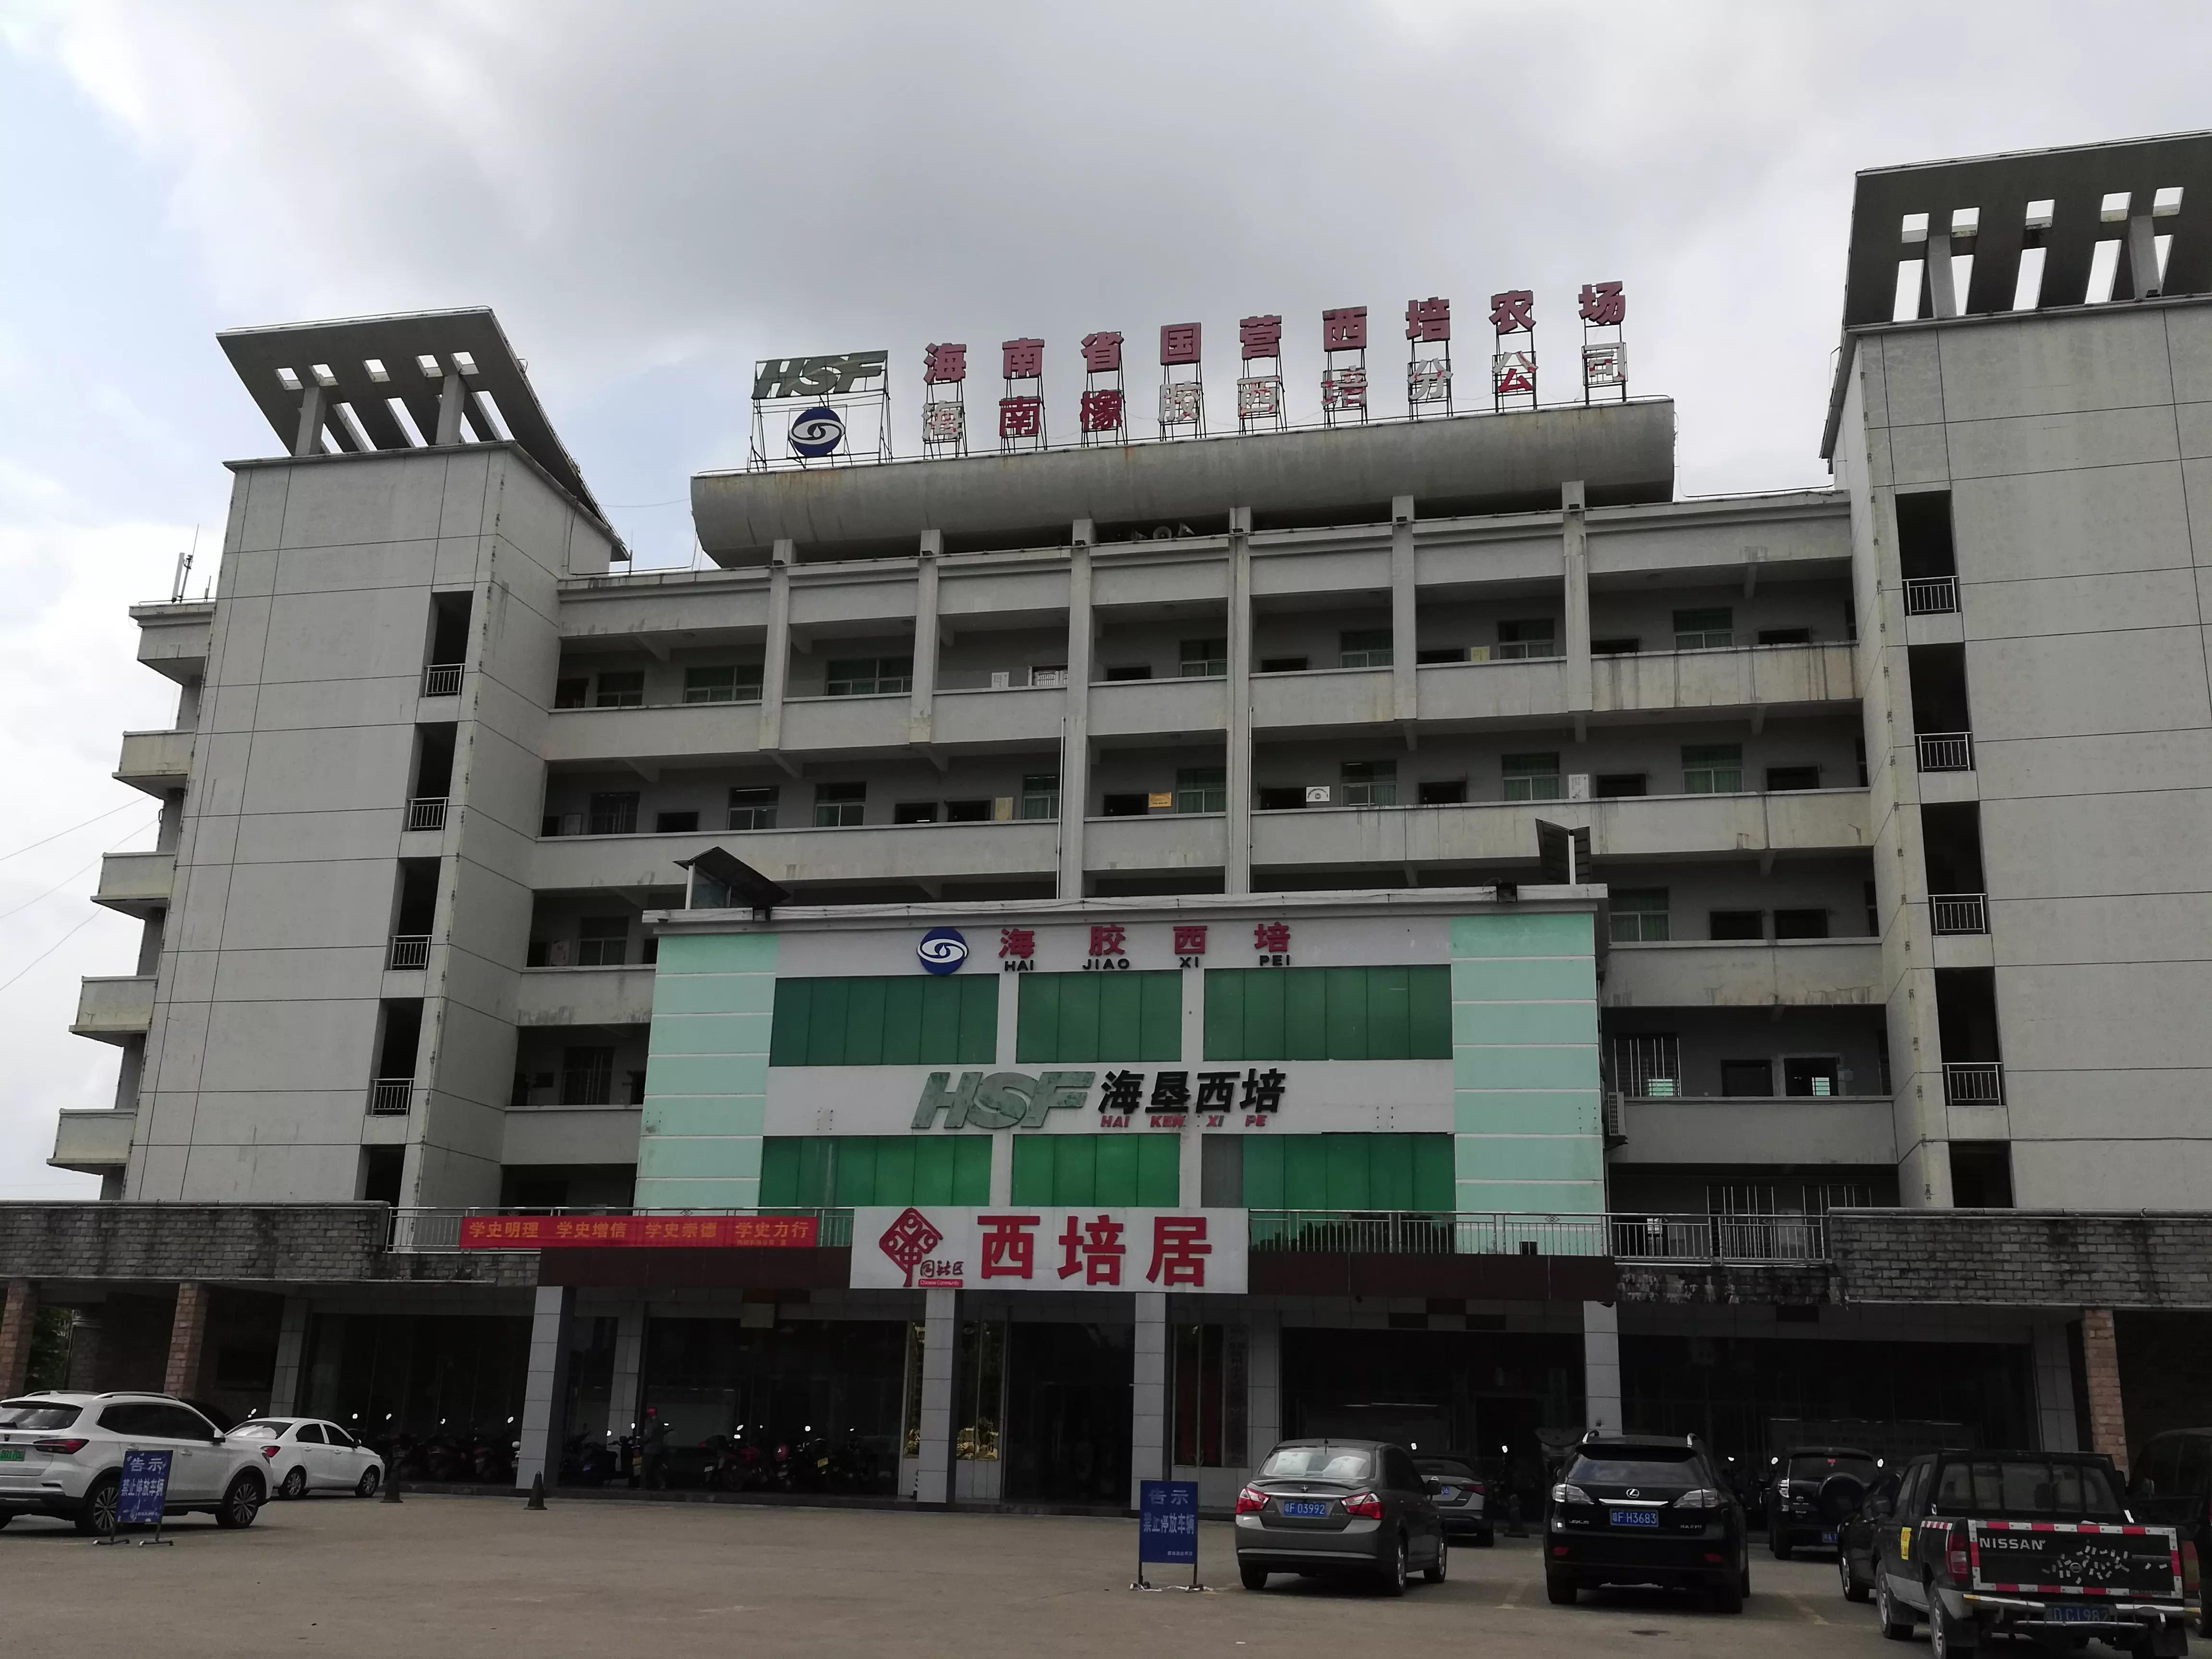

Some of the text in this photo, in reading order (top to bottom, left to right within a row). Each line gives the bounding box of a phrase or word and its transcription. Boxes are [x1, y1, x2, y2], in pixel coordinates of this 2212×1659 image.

[924, 281, 1626, 384] 海南省国营西培农场
[751, 350, 888, 399] HSF
[921, 343, 1626, 441] 海南橡胶西培分公司
[998, 922, 1290, 959] 海胶西培
[1004, 955, 1290, 972] HAI JIAO XI PEI
[911, 1071, 1095, 1129] HSF
[1098, 1068, 1286, 1114] 海垦西培
[1100, 1115, 1129, 1128] HAI
[1150, 1115, 1185, 1127] KEN
[469, 1221, 539, 1238] 学史明理
[556, 1221, 627, 1238] 学史增信
[978, 1215, 1212, 1287] 西培居
[130, 1457, 163, 1472] 告示
[121, 1479, 164, 1496] 禁止停放车辆
[1149, 1488, 1189, 1505] 告示
[1143, 1511, 1194, 1534] 禁止停放车辆
[1979, 1538, 2043, 1551] NISSAN
